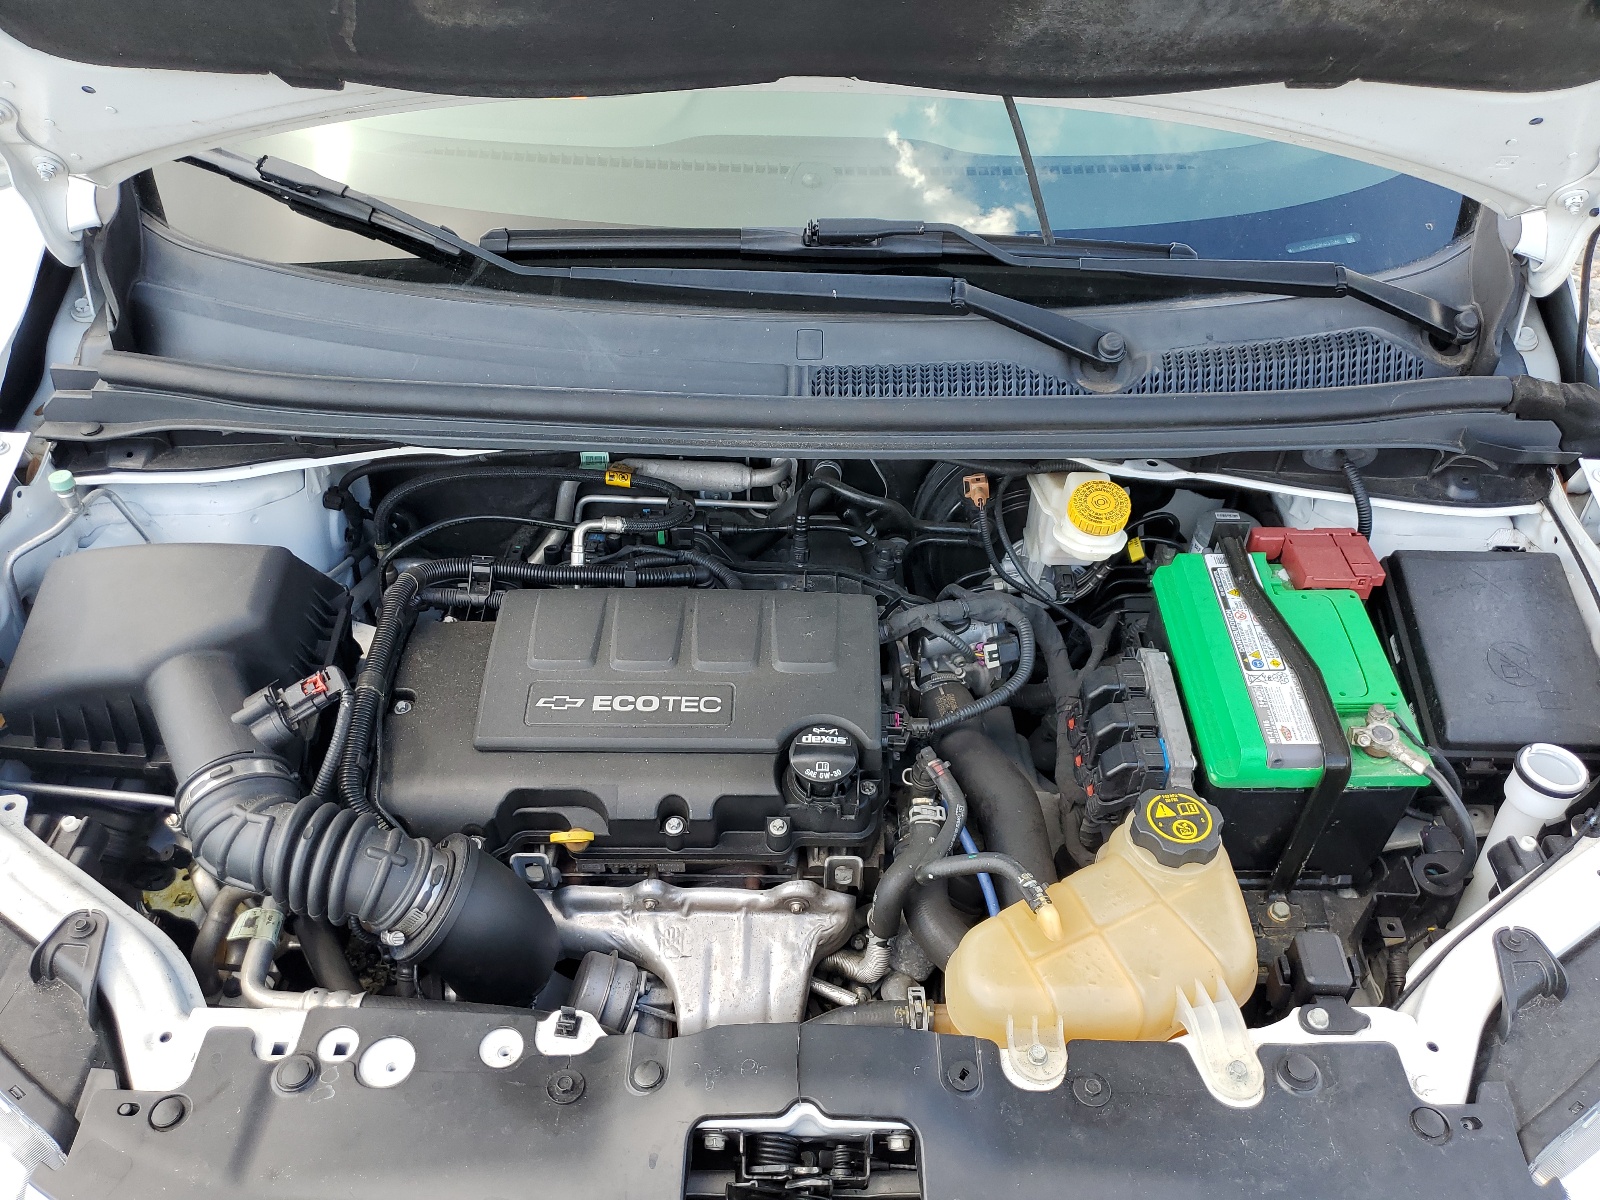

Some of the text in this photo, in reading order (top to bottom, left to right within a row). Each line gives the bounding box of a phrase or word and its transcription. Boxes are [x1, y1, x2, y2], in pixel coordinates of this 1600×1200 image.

[592, 695, 722, 713] ECOTEC
[802, 733, 847, 744] dexos
[804, 768, 842, 779] SAE 5W-30
